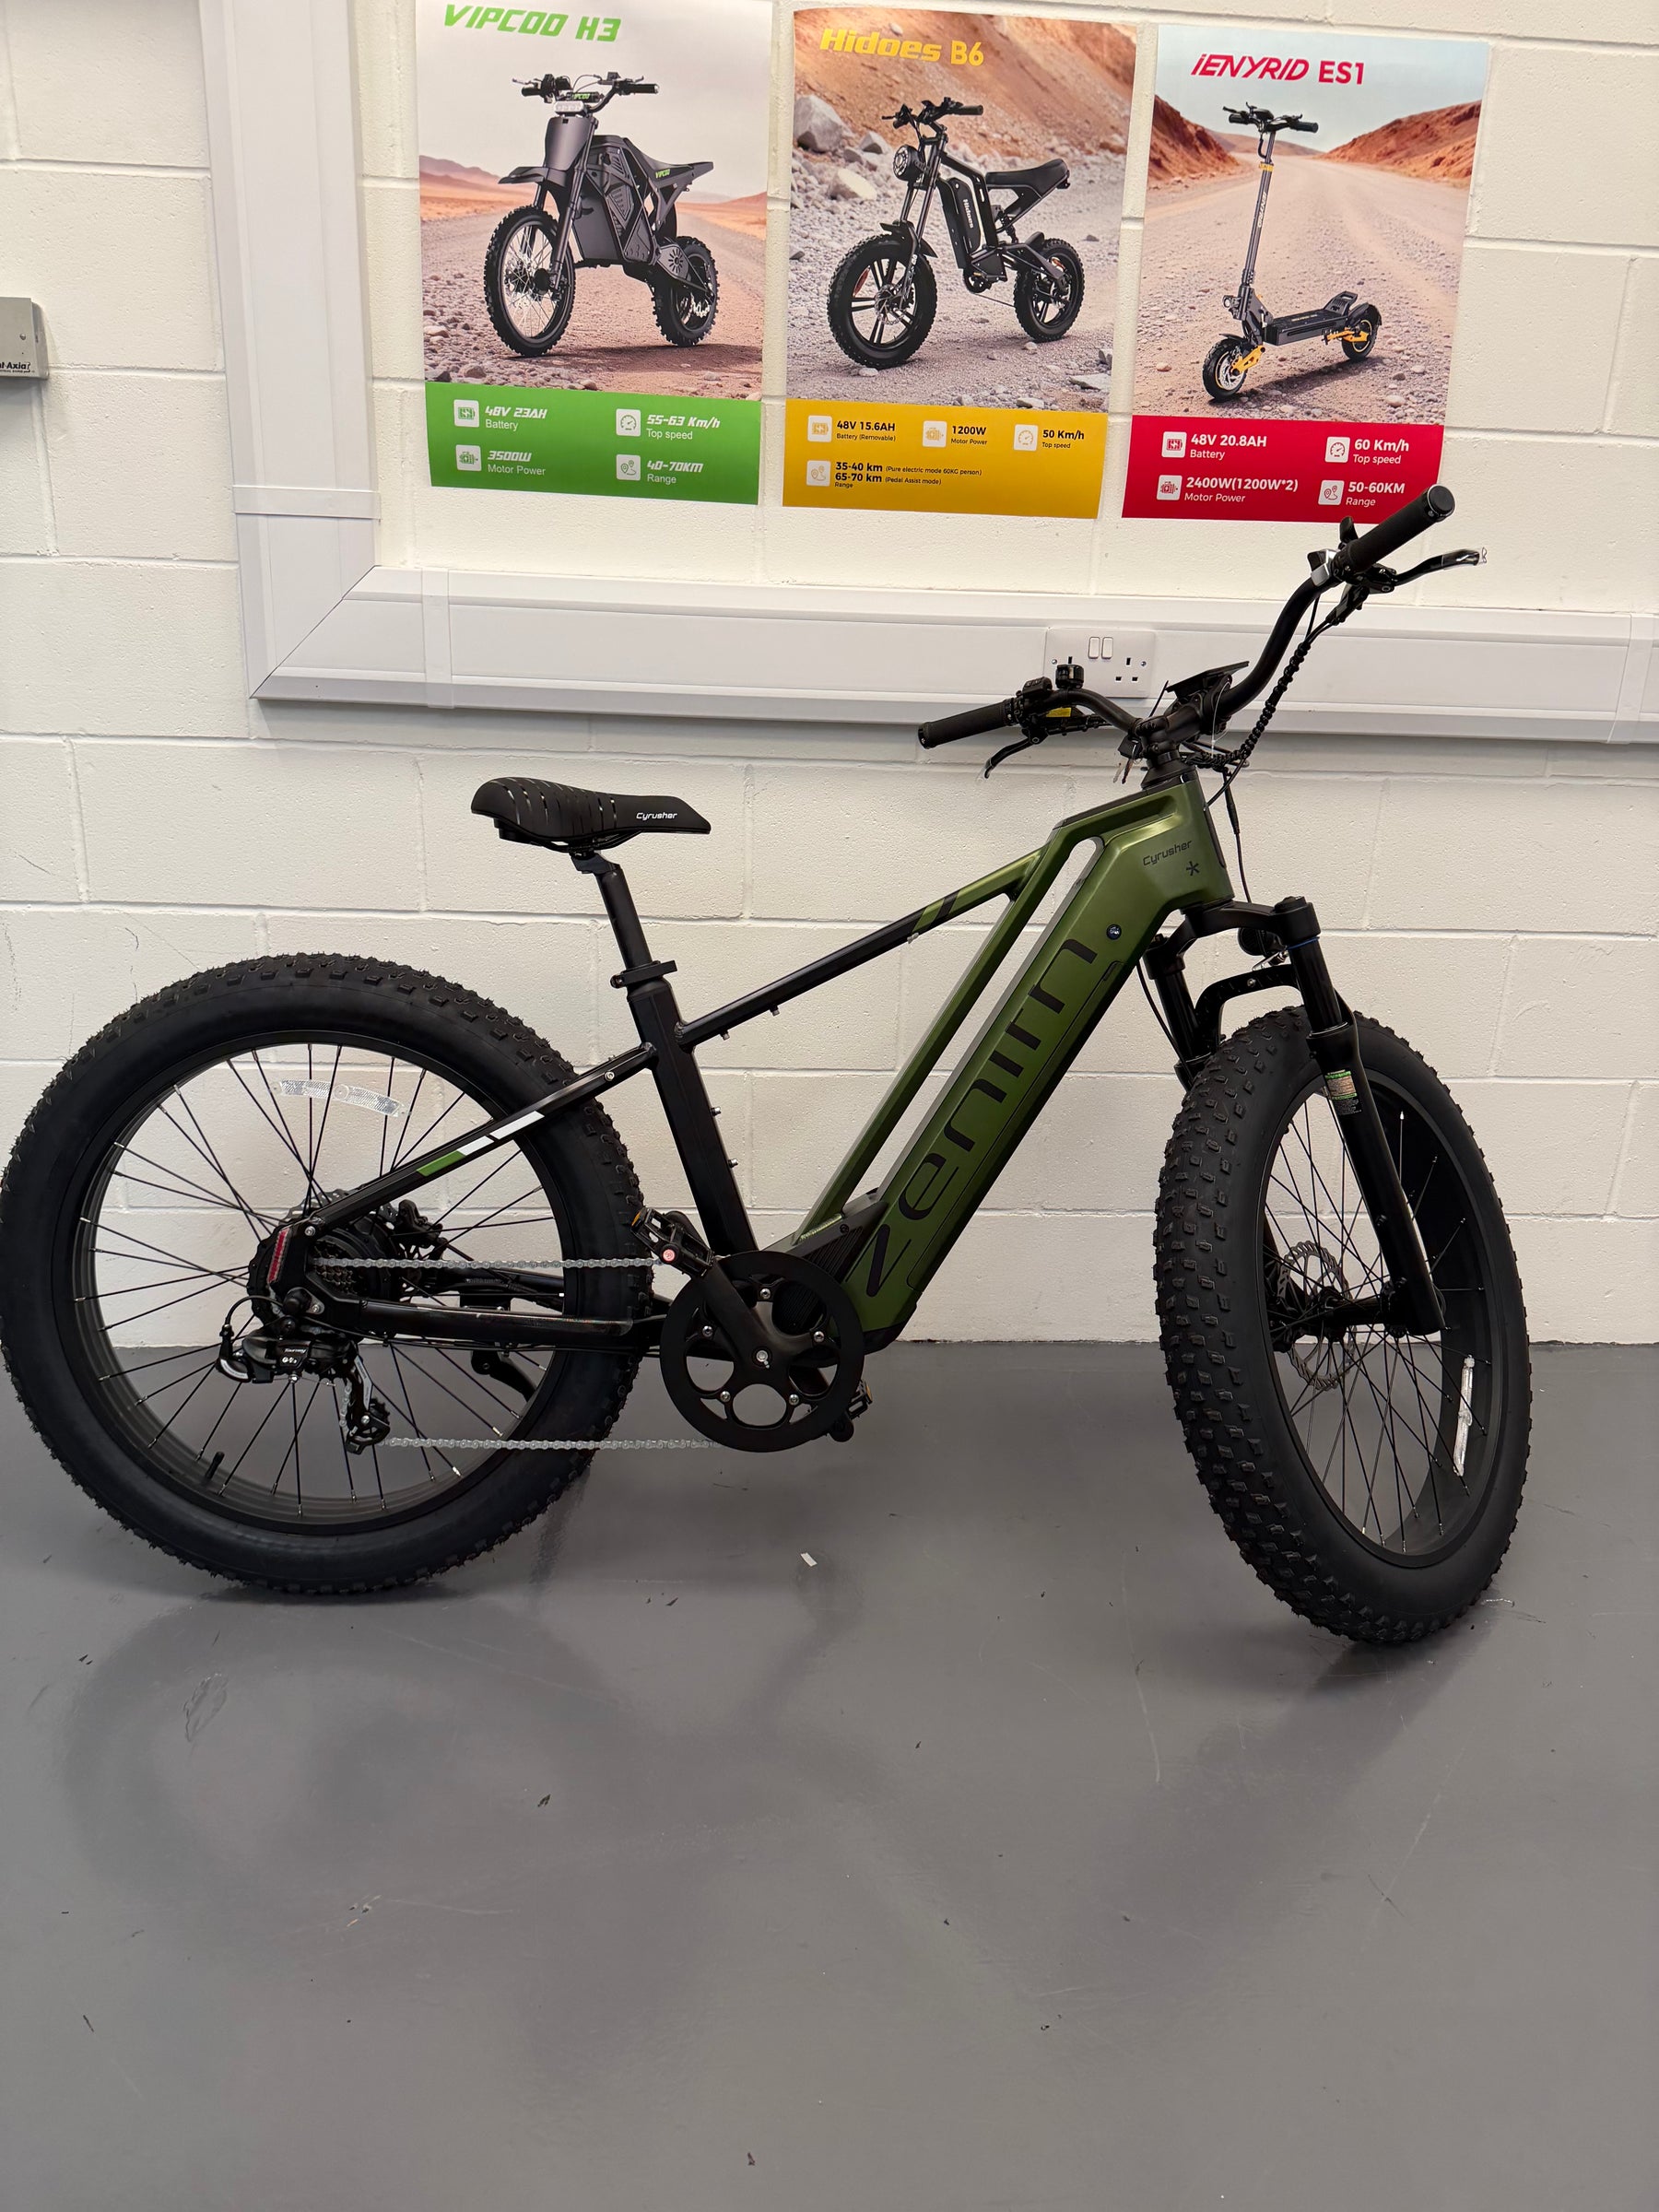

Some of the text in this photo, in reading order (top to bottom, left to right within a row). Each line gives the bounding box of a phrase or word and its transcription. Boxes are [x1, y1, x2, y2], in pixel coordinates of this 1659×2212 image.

[444, 4, 621, 42] VIPCOO H3
[819, 29, 984, 66] Hidoes B6
[1318, 60, 1364, 85] ES1
[485, 406, 547, 419] 48V 23AH
[485, 418, 518, 431] Battery
[646, 414, 721, 429] 55-63 Km/h
[837, 420, 896, 431] 48V 15.6AH
[646, 429, 693, 441] Top speed
[951, 425, 987, 436] 1200W
[1042, 429, 1085, 441] 50 Km/h
[836, 433, 896, 442] Battery (Removable)
[1191, 433, 1267, 448] 48V 20.8AH
[1042, 441, 1053, 450] Top
[1355, 439, 1409, 453] 60 Km/h
[487, 450, 532, 463] 3500W
[1190, 450, 1225, 461] Battery
[1353, 453, 1402, 465] Top speed
[488, 464, 546, 476] Motor Power
[647, 460, 703, 473] 40-70KM
[835, 462, 864, 471] 35-40
[866, 463, 883, 472] km
[647, 473, 677, 485] Range
[835, 473, 863, 482] 65-70
[865, 474, 882, 483] km
[1347, 481, 1406, 494] 50-60KM
[1184, 492, 1246, 503] Motor Power
[1346, 497, 1376, 508] Range
[636, 811, 677, 821] Cyrusher
[1143, 840, 1192, 866] Cyrusher
